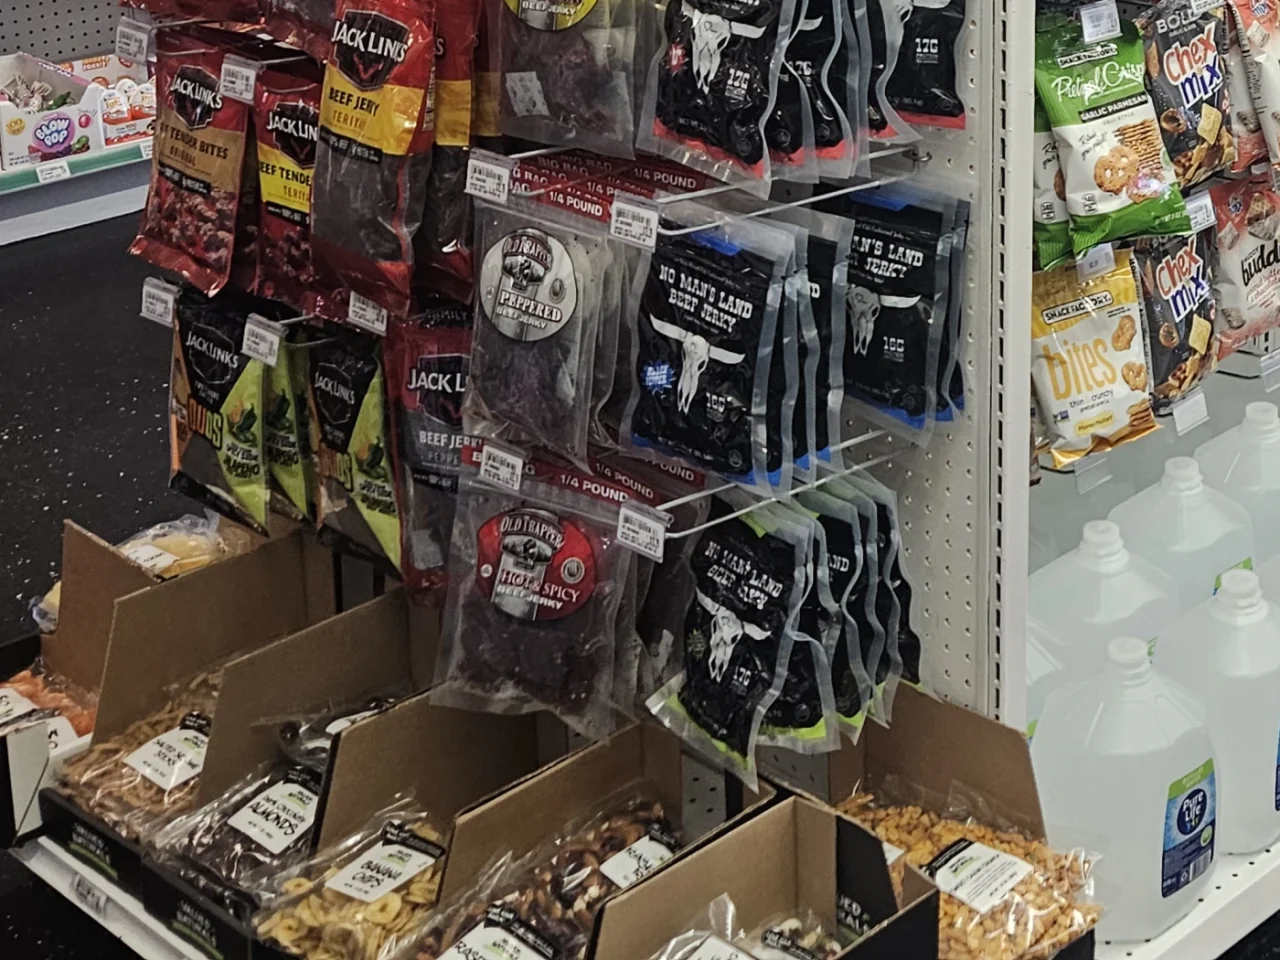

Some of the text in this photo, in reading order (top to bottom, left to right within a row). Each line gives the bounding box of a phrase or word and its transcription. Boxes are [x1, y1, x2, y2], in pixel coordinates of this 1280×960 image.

[331, 21, 367, 52] JACK
[915, 38, 938, 52] 17G
[1060, 55, 1083, 67] SNACK
[1163, 23, 1217, 85] Chex
[171, 78, 196, 100] JACK
[727, 70, 749, 88] 17G
[1178, 55, 1224, 109] mix
[329, 87, 353, 106] BEEF
[1081, 94, 1148, 122] GARLIC PARMESAN
[35, 118, 70, 138] BLOW
[199, 138, 228, 159] BITES
[634, 168, 696, 189] 1/4 POUND
[549, 192, 603, 216] 1/4 POUND
[863, 257, 907, 278] JERKY
[888, 244, 923, 267] LAND
[1156, 238, 1202, 300] Chex
[660, 263, 753, 319] NO MAN'S LAND
[499, 292, 563, 323] PEPPERED
[669, 288, 737, 333] BEEF JERKY
[1045, 305, 1071, 321] SNACK
[1042, 339, 1117, 401] bites
[419, 431, 447, 445] BEEF
[560, 474, 628, 502] 1/4 POUND
[595, 463, 654, 499] 1/4 POUND
[500, 516, 564, 546] OLD TRAPPER
[501, 571, 580, 603] HOT SPICY
[750, 571, 783, 597] LAND
[526, 594, 563, 611] JERKY
[1183, 789, 1205, 811] Pure
[250, 801, 298, 836] ALMONDS
[361, 860, 402, 880] BANANA
